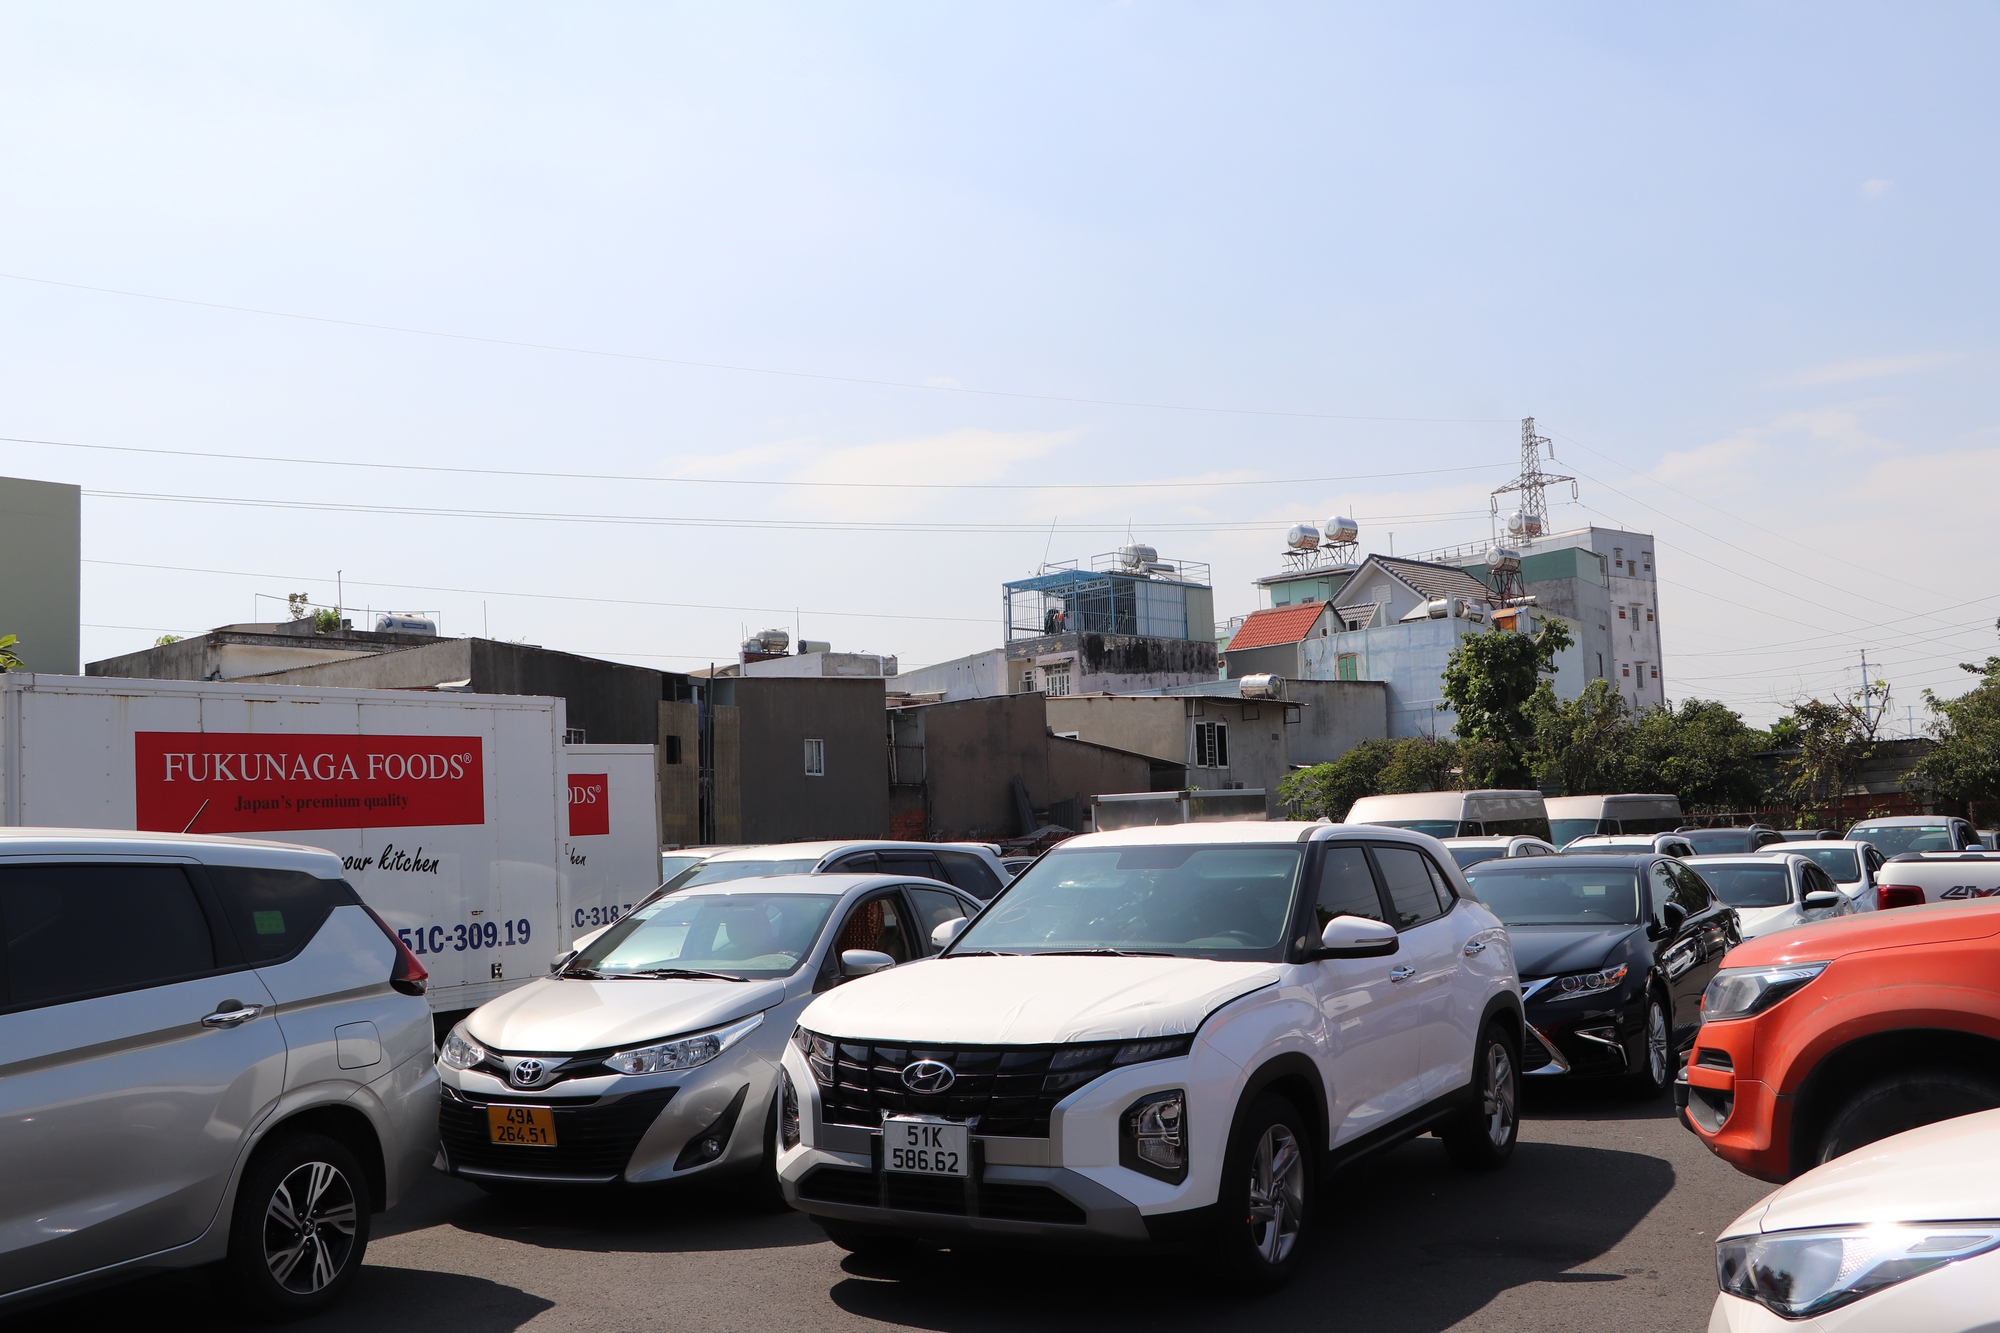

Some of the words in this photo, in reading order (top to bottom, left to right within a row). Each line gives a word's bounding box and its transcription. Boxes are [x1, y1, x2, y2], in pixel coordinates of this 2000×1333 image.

[163, 753, 360, 782] FUKUNAGA
[234, 795, 292, 813] Japan's
[296, 795, 360, 812] premium
[364, 793, 409, 808] quality
[341, 855, 373, 872] our
[378, 844, 440, 874] kitchen
[398, 918, 531, 955] 51C-309.19
[506, 1108, 534, 1125] 49A
[497, 1126, 547, 1143] 264.51
[907, 1125, 943, 1148] 51K
[893, 1148, 959, 1173] 586.62
